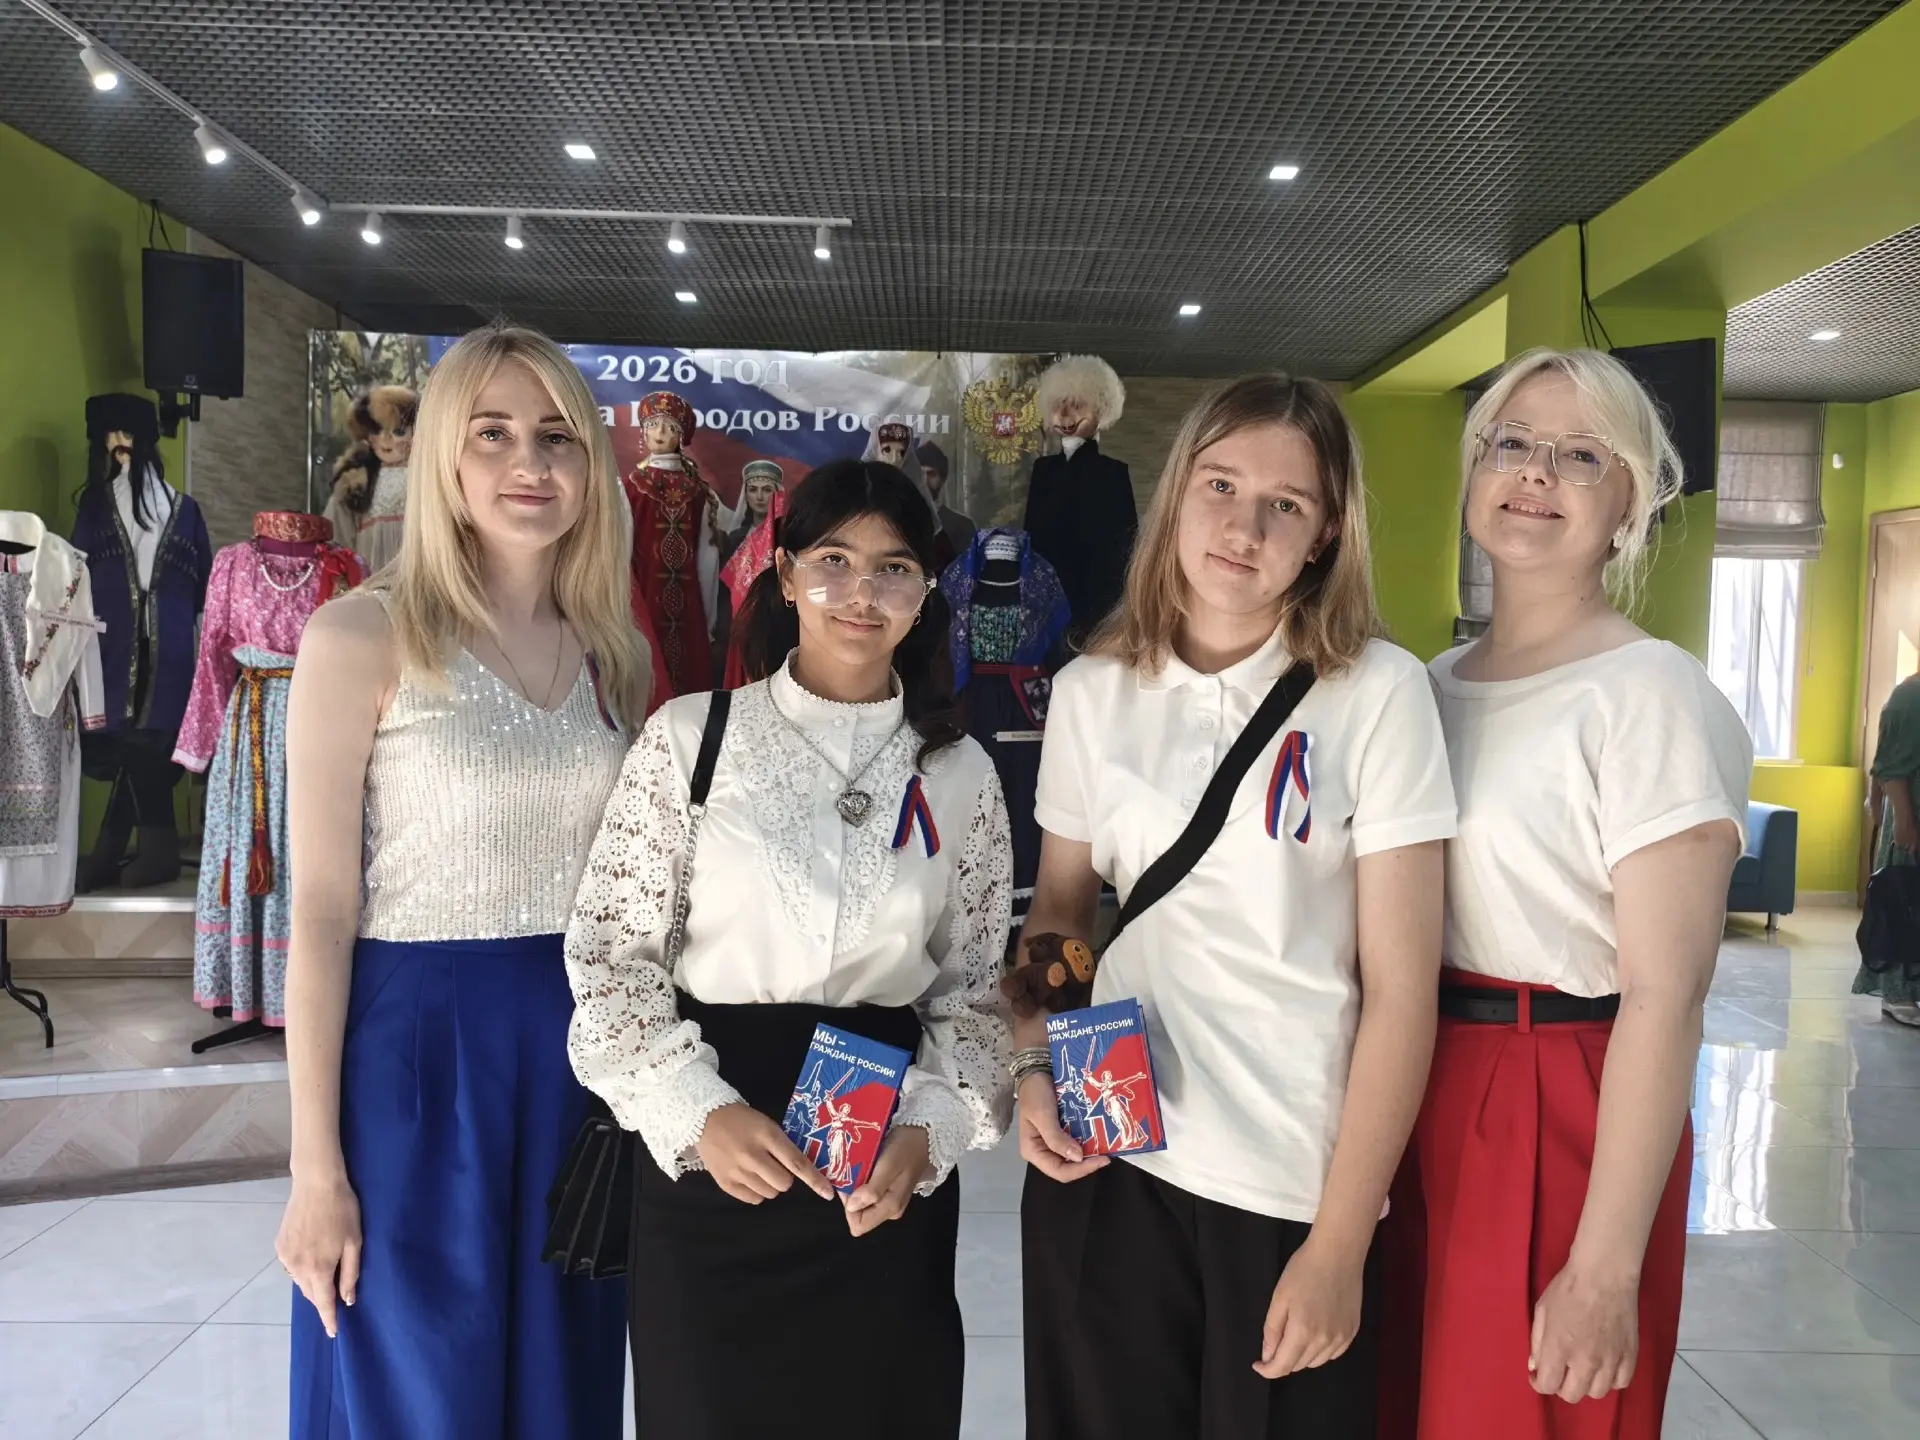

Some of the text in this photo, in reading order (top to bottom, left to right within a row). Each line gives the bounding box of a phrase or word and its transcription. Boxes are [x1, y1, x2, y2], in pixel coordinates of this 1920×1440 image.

[596, 355, 792, 394] 2026 ГОД
[812, 1029, 838, 1046] МЫ
[1046, 1017, 1069, 1033] МЫ
[1048, 1018, 1134, 1043] ГРАЖДАНЕ РОССИИ!
[809, 1041, 896, 1078] ГРАЖДАНЕ РОССИИ!
